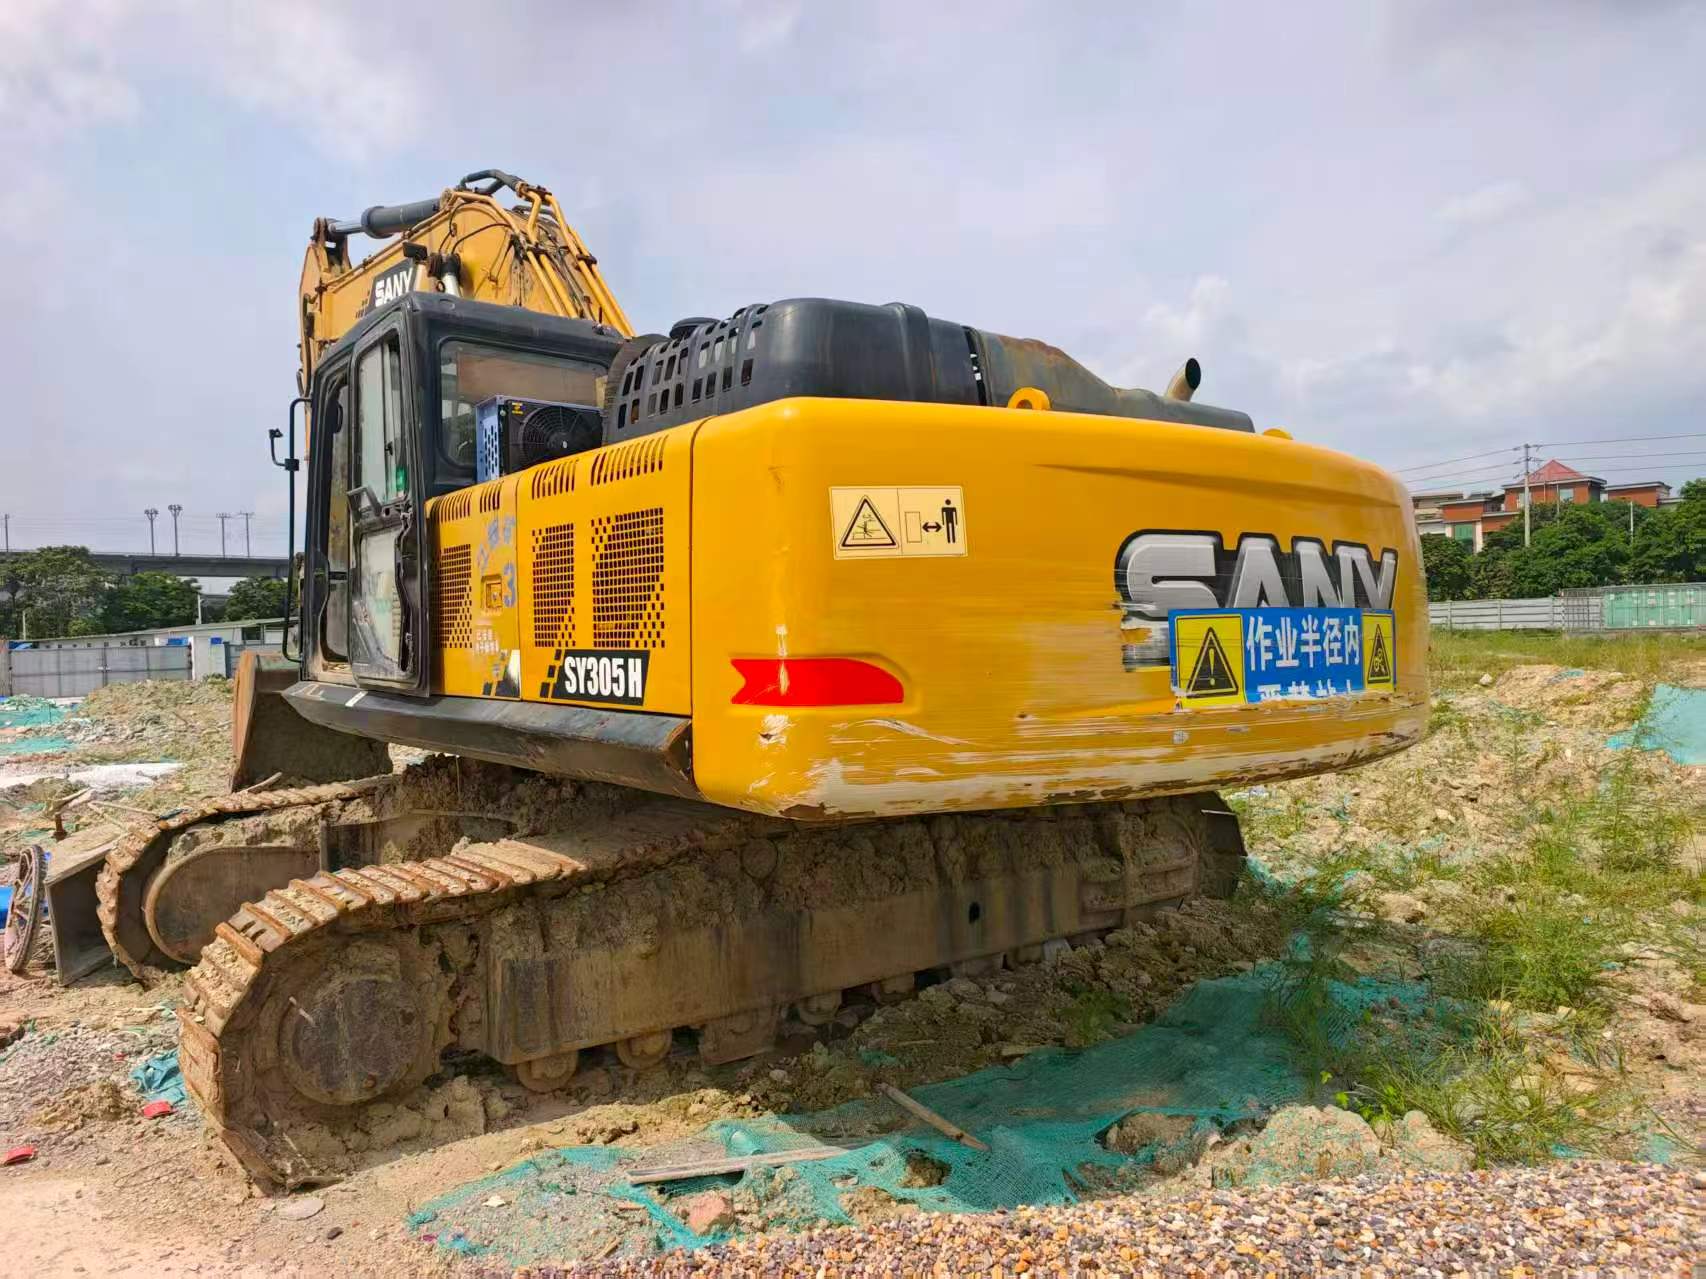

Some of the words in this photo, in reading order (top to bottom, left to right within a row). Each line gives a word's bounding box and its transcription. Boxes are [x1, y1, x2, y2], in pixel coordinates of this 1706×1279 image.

[375, 267, 413, 307] SANY
[1246, 614, 1360, 671] 作业半径内
